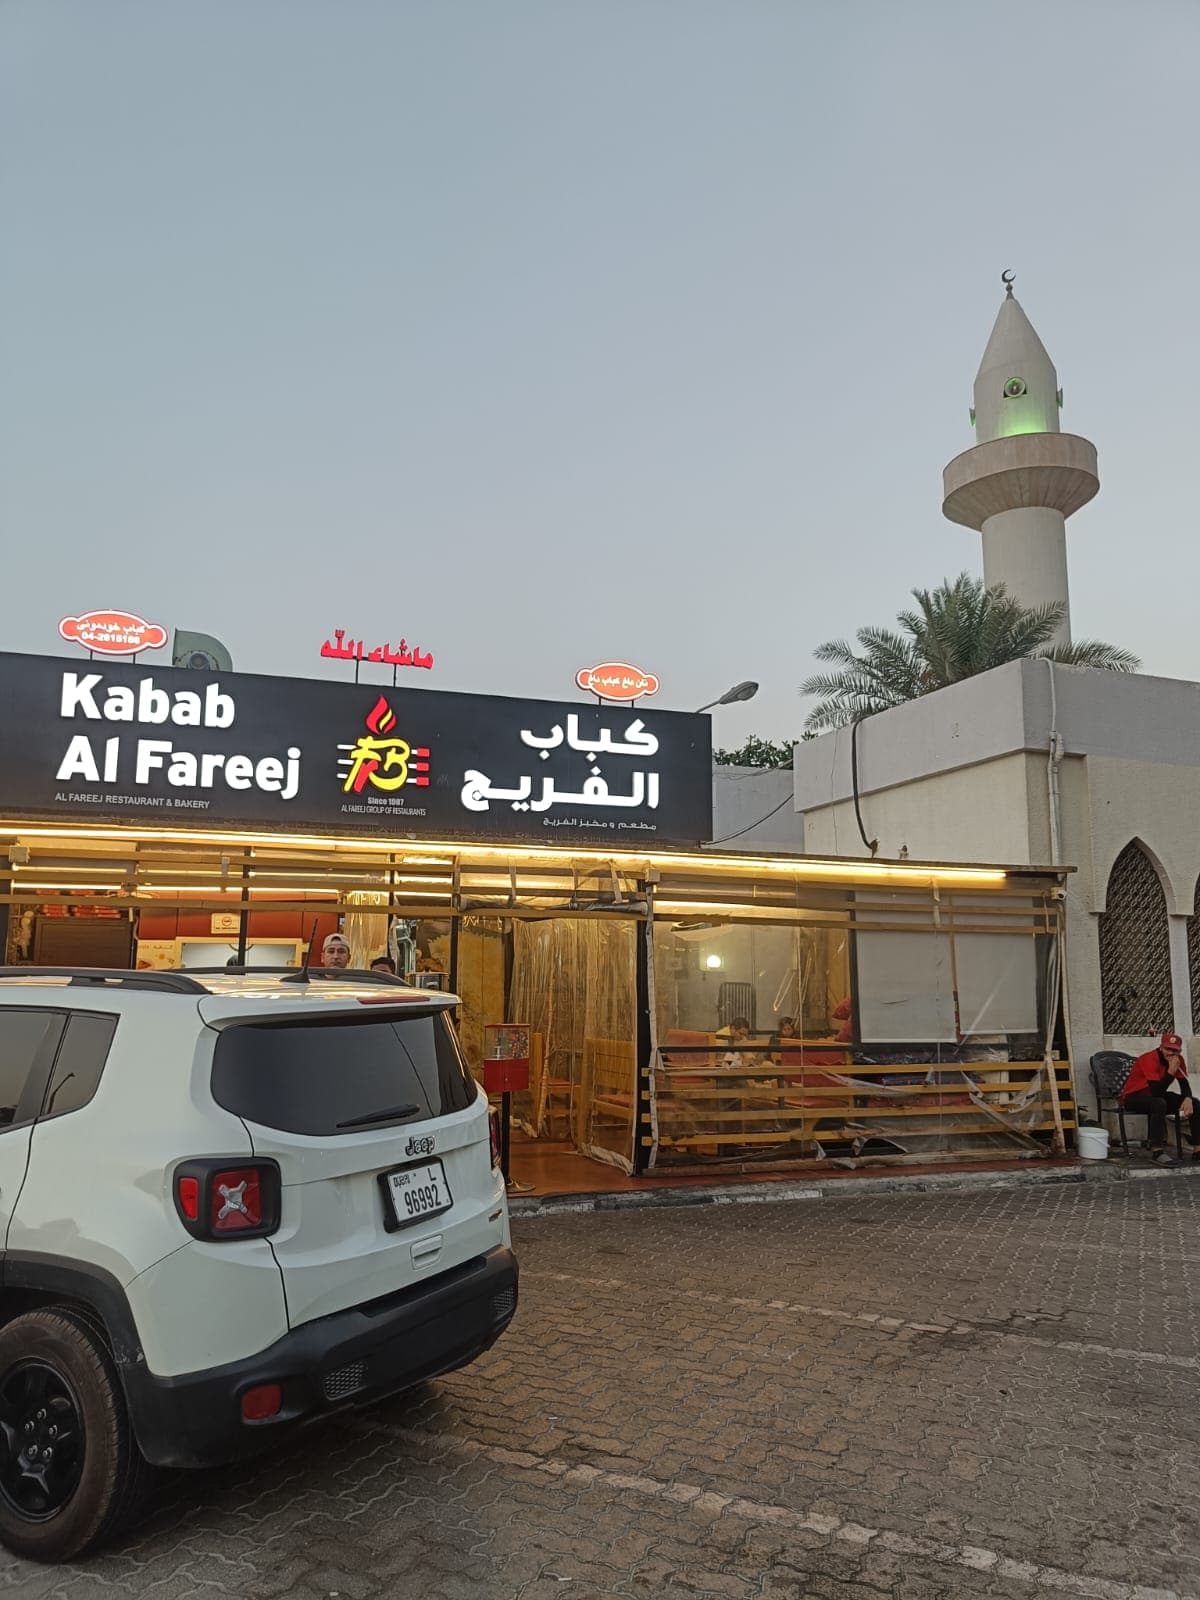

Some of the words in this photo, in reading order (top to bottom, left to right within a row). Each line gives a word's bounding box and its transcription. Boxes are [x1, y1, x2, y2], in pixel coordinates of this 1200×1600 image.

[60, 672, 235, 728] Kabab
[520, 713, 660, 762] كباب
[55, 735, 120, 783] Al
[135, 739, 301, 800] Fareej
[460, 765, 660, 812] الفريج
[54, 792, 67, 802] AL
[68, 793, 103, 803] FAREEJ
[105, 795, 165, 807] RESTAURANT
[166, 799, 172, 807] &
[174, 799, 210, 809] BAKERY
[341, 804, 348, 812] AL
[366, 805, 384, 814] GROUP
[385, 806, 392, 814] OF
[367, 797, 387, 805] Since
[543, 817, 577, 827] الفريج
[618, 821, 657, 831] مطعم
[405, 1135, 435, 1156] Jeep
[427, 1167, 437, 1182] L
[404, 1183, 442, 1215] 96992
